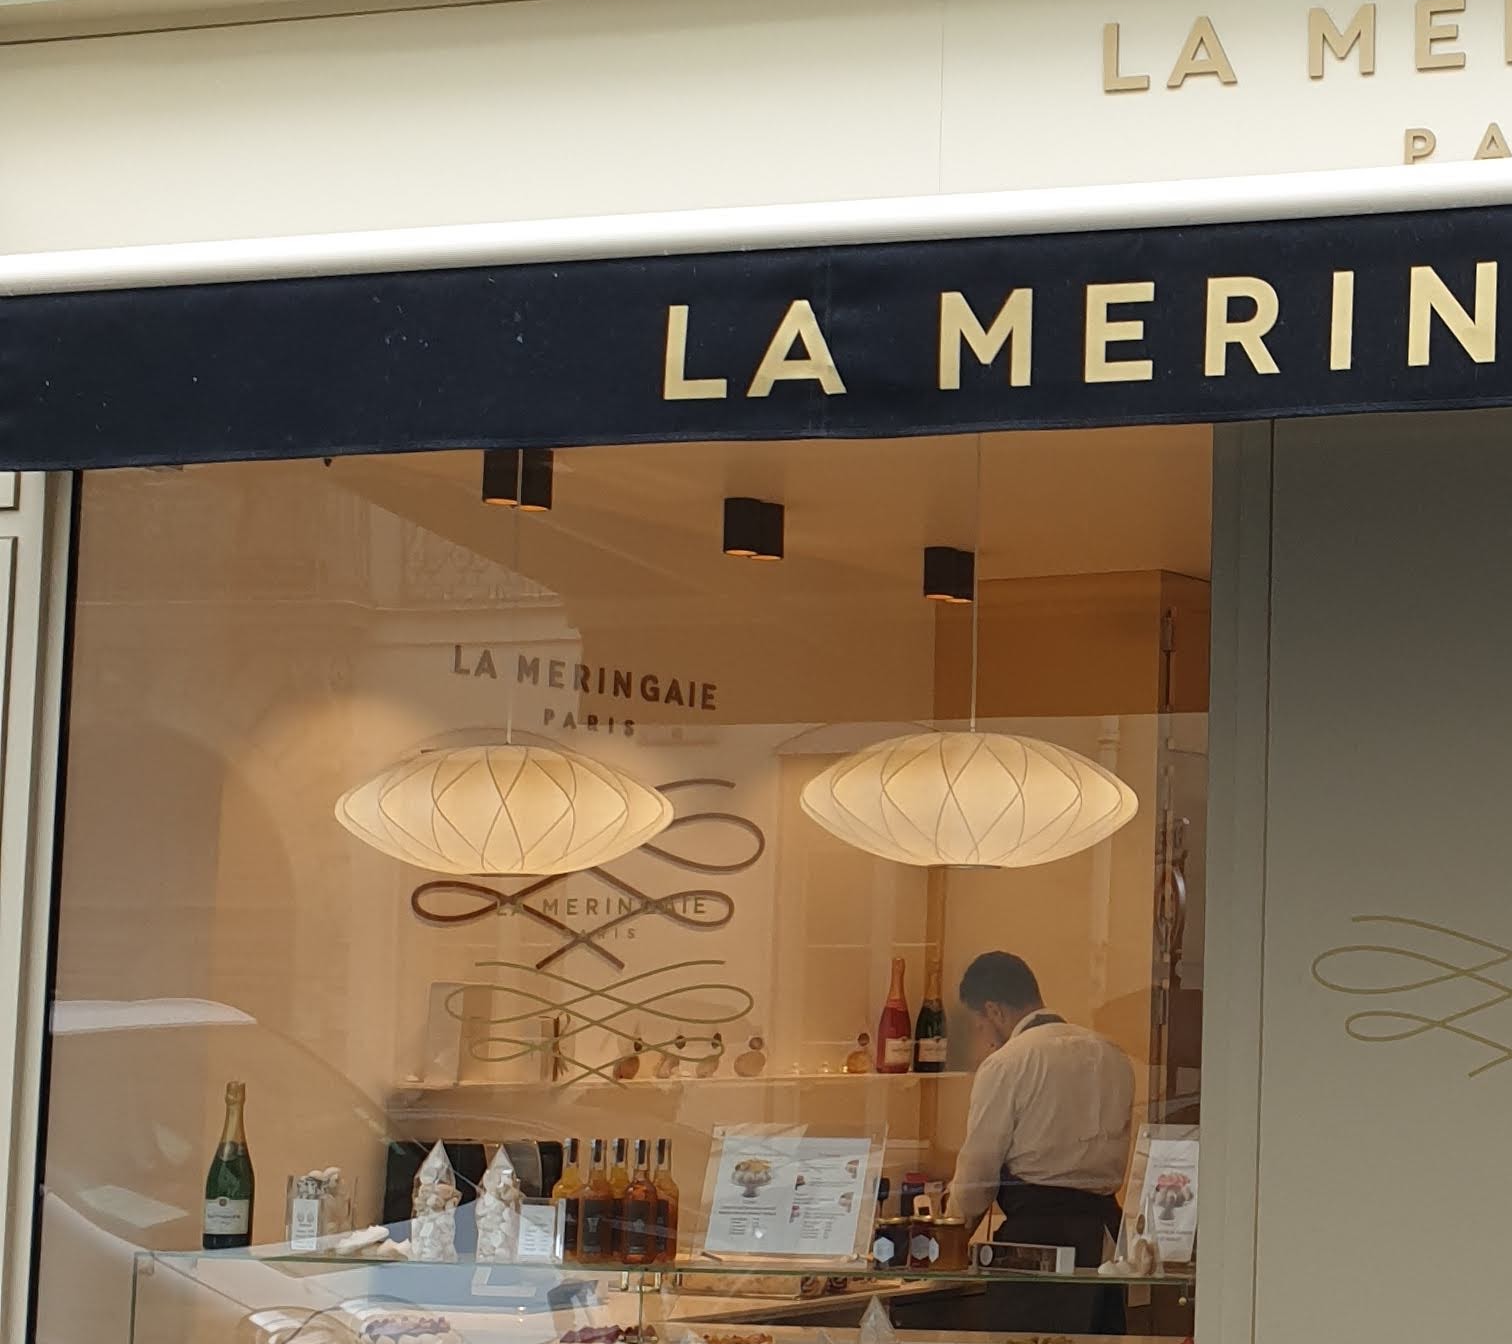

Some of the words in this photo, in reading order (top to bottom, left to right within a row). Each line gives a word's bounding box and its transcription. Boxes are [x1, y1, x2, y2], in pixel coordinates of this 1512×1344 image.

[1102, 14, 1238, 93] LA
[663, 298, 847, 401] LA
[452, 644, 498, 680] LA
[516, 654, 719, 711] MERINGAIE
[542, 708, 637, 737] PARIS
[541, 896, 708, 916] MERINAIE
